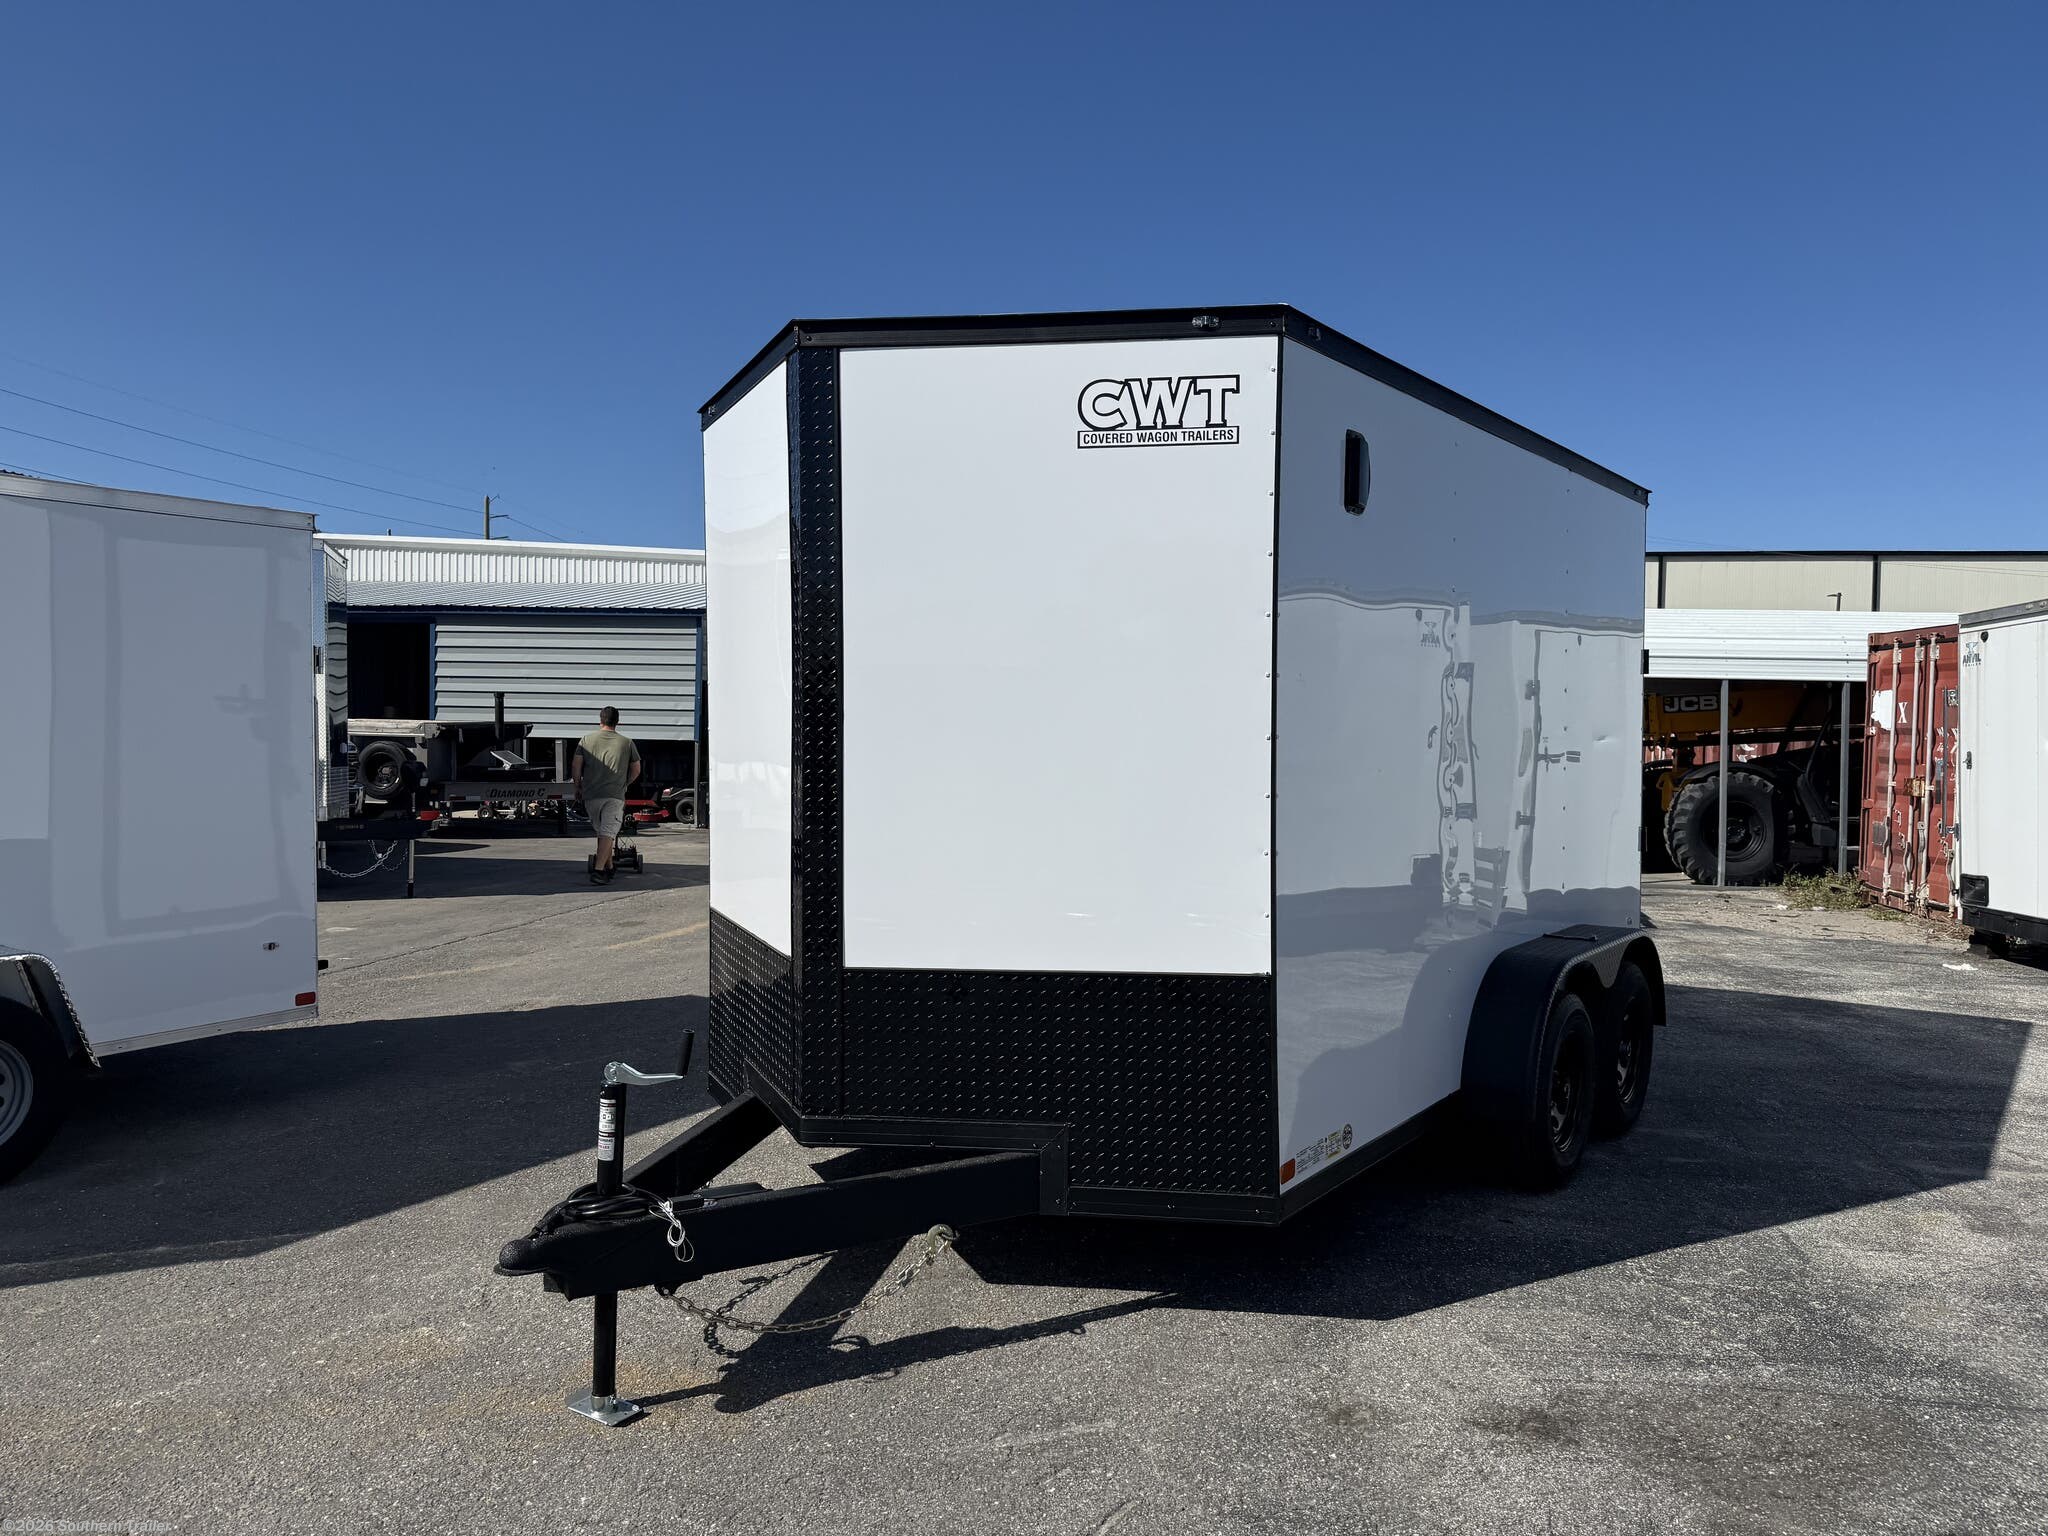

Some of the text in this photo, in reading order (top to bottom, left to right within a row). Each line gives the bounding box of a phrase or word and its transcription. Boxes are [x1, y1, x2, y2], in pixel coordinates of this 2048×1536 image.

[1078, 374, 1240, 430] CWT
[1083, 429, 1234, 445] COVERED WAGON TRAILERS
[1664, 695, 1718, 712] JCB
[490, 788, 535, 798] DIAMOND
